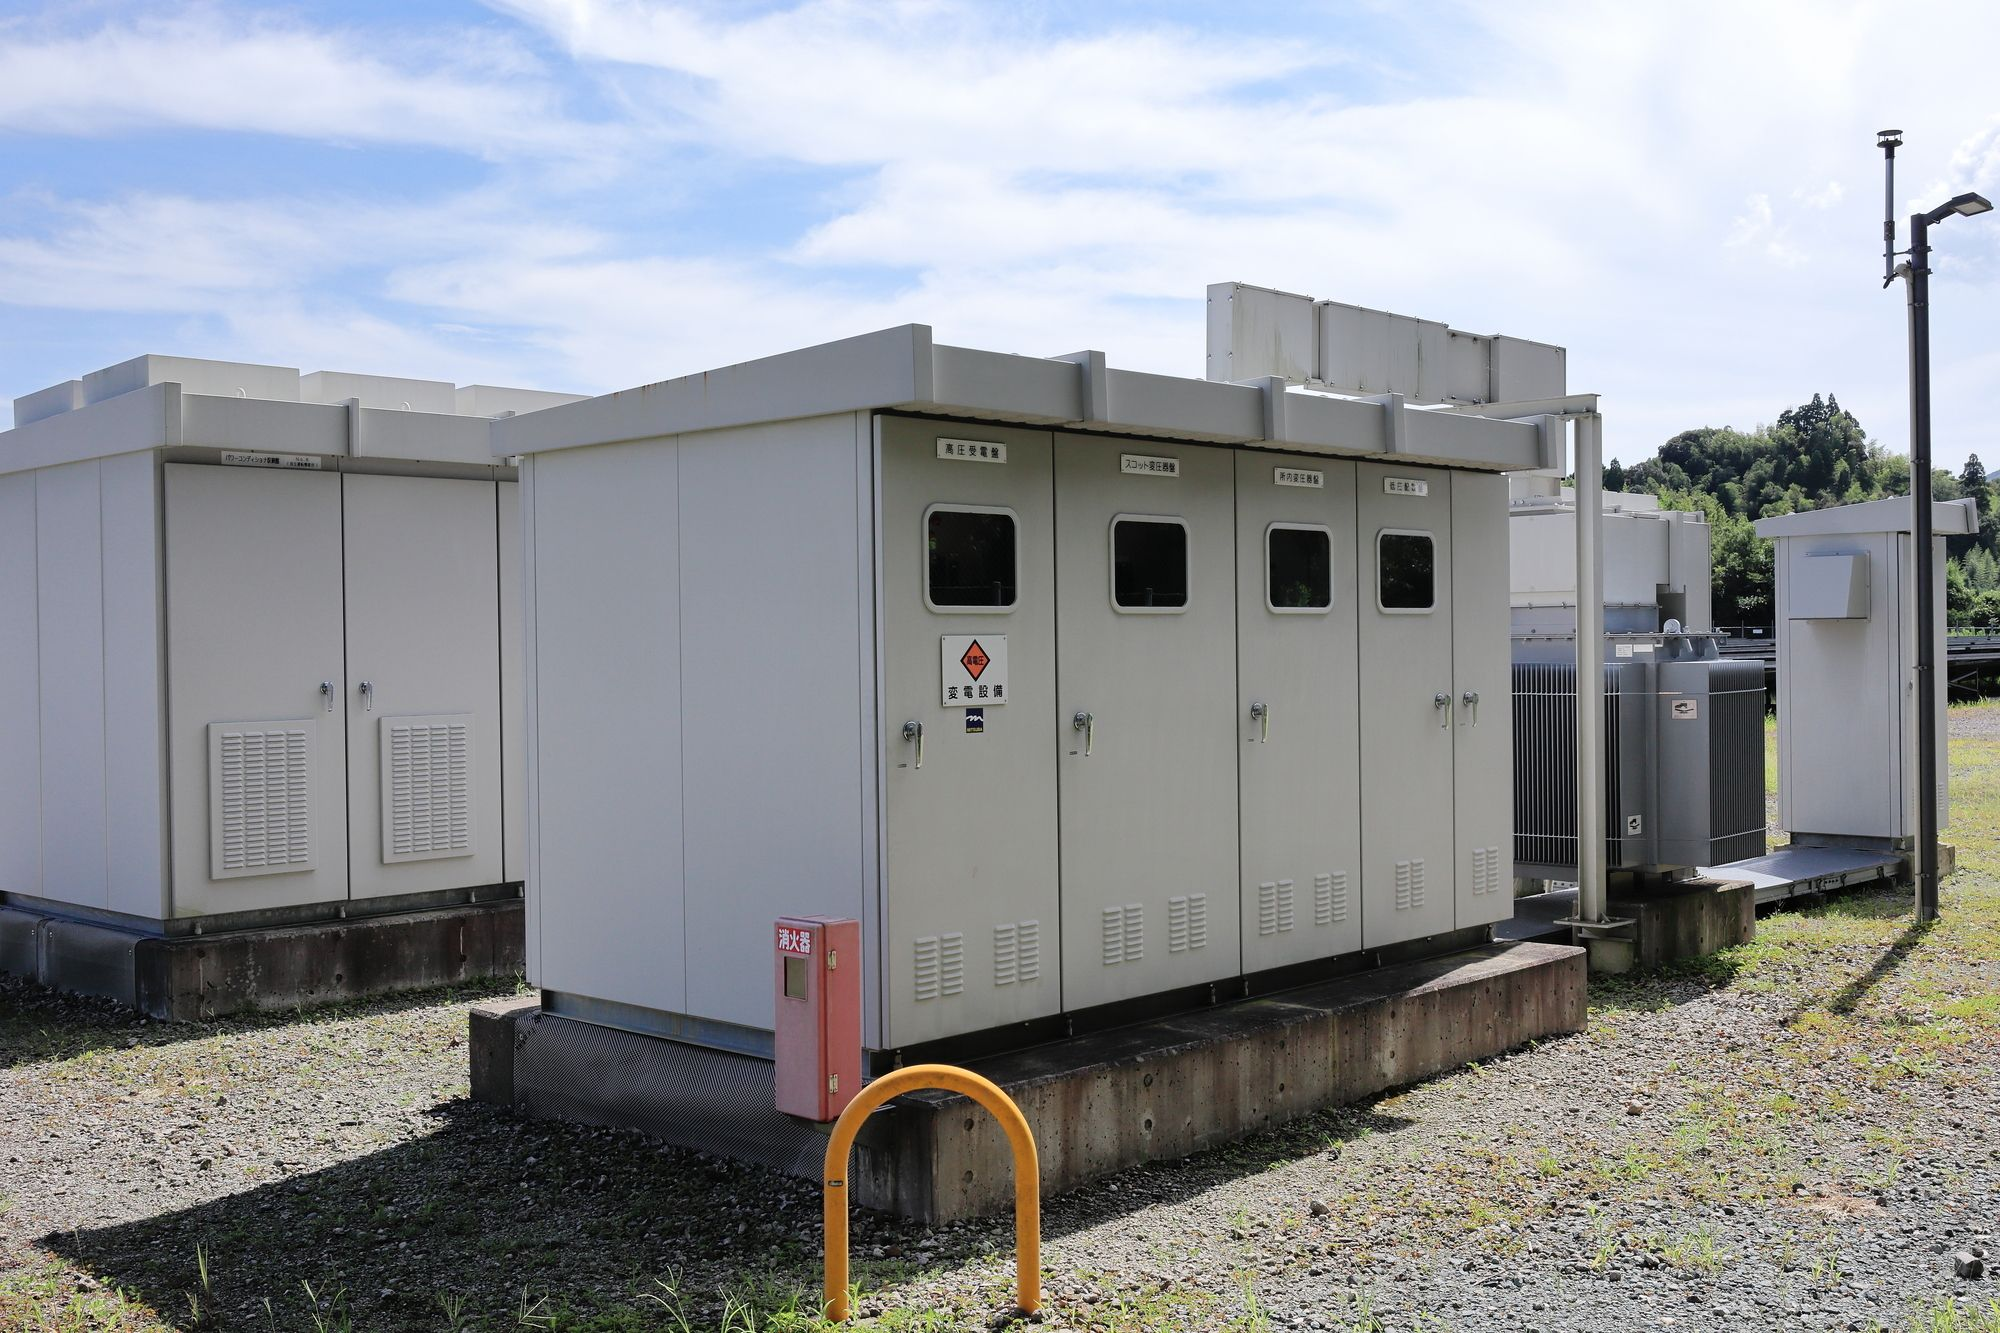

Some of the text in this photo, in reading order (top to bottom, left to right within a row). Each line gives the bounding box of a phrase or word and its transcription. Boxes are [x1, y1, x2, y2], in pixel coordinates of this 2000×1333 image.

[945, 443, 999, 459] 高圧受電盤
[1125, 459, 1176, 473] スコット変圧器盤
[966, 655, 984, 666] 高電圧
[948, 684, 1003, 700] 変電設備
[778, 928, 811, 954] 消火器
